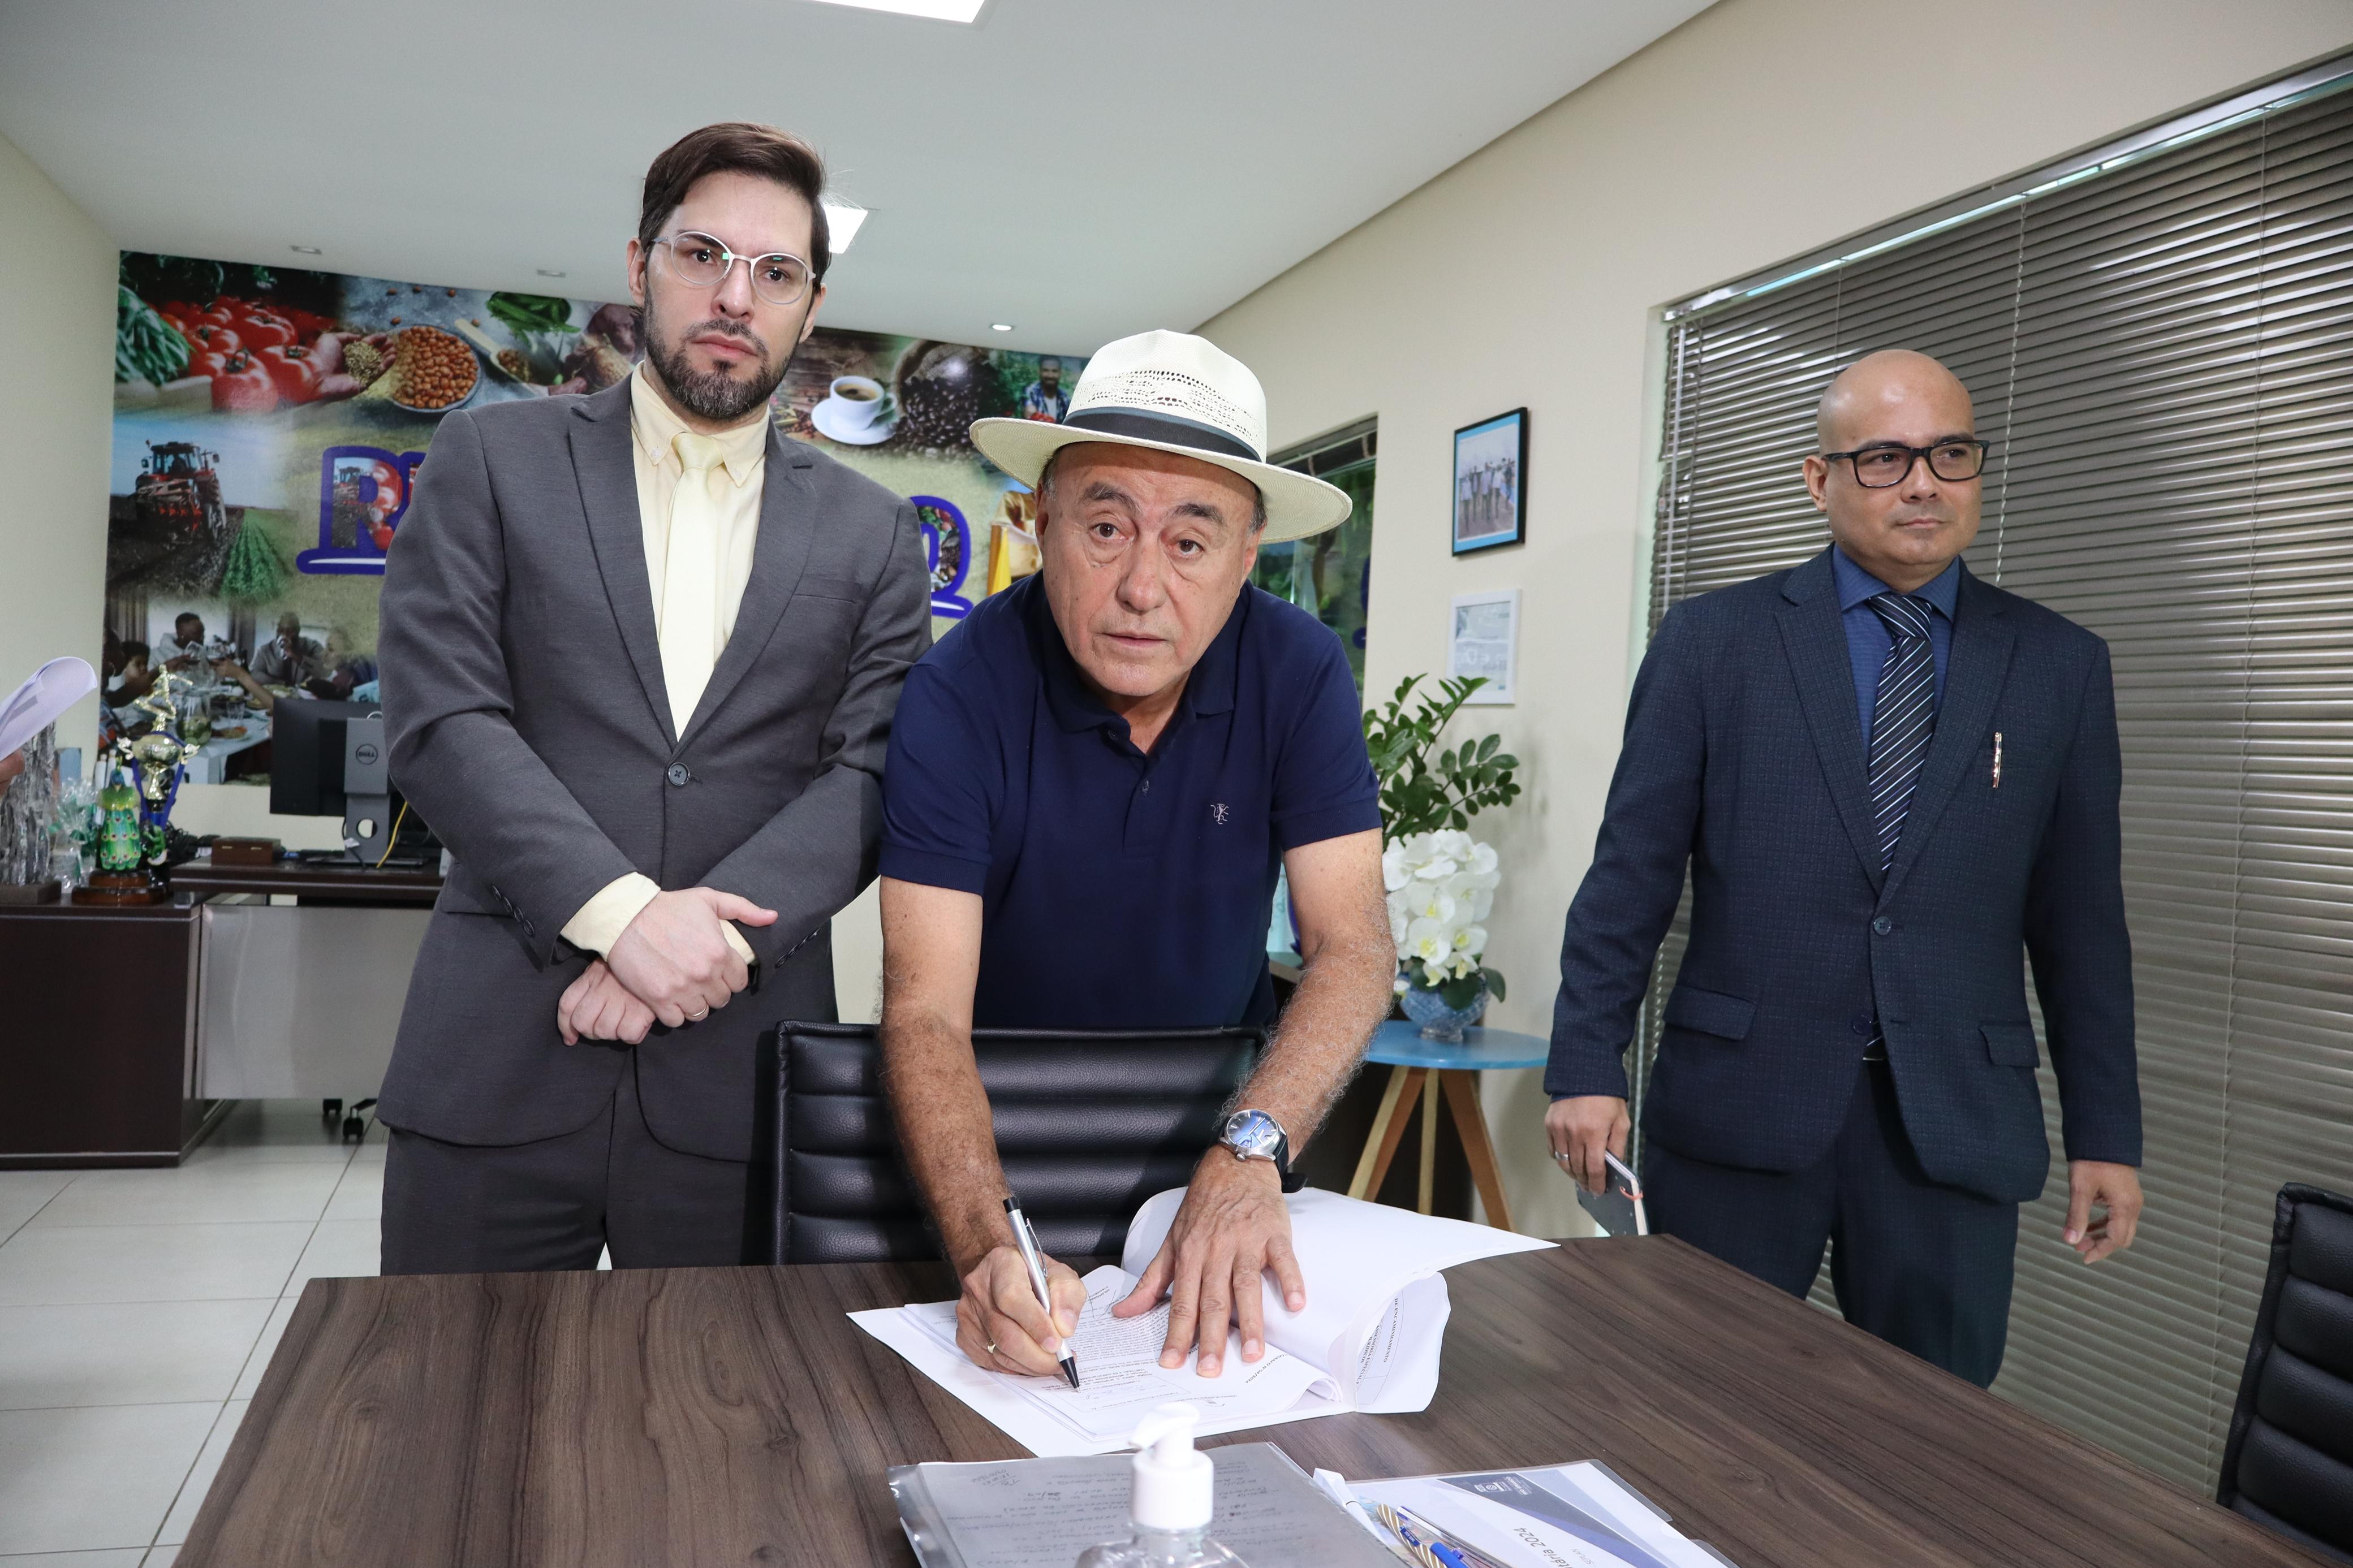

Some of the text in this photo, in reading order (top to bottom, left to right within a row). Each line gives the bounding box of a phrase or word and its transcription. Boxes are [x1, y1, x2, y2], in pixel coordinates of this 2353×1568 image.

[1383, 1298, 1398, 1363] DE ENCAMINHAMENTO
[1358, 1357, 1371, 1380] ESPECIAL
[1513, 1527, 1574, 1568] tária 2024
